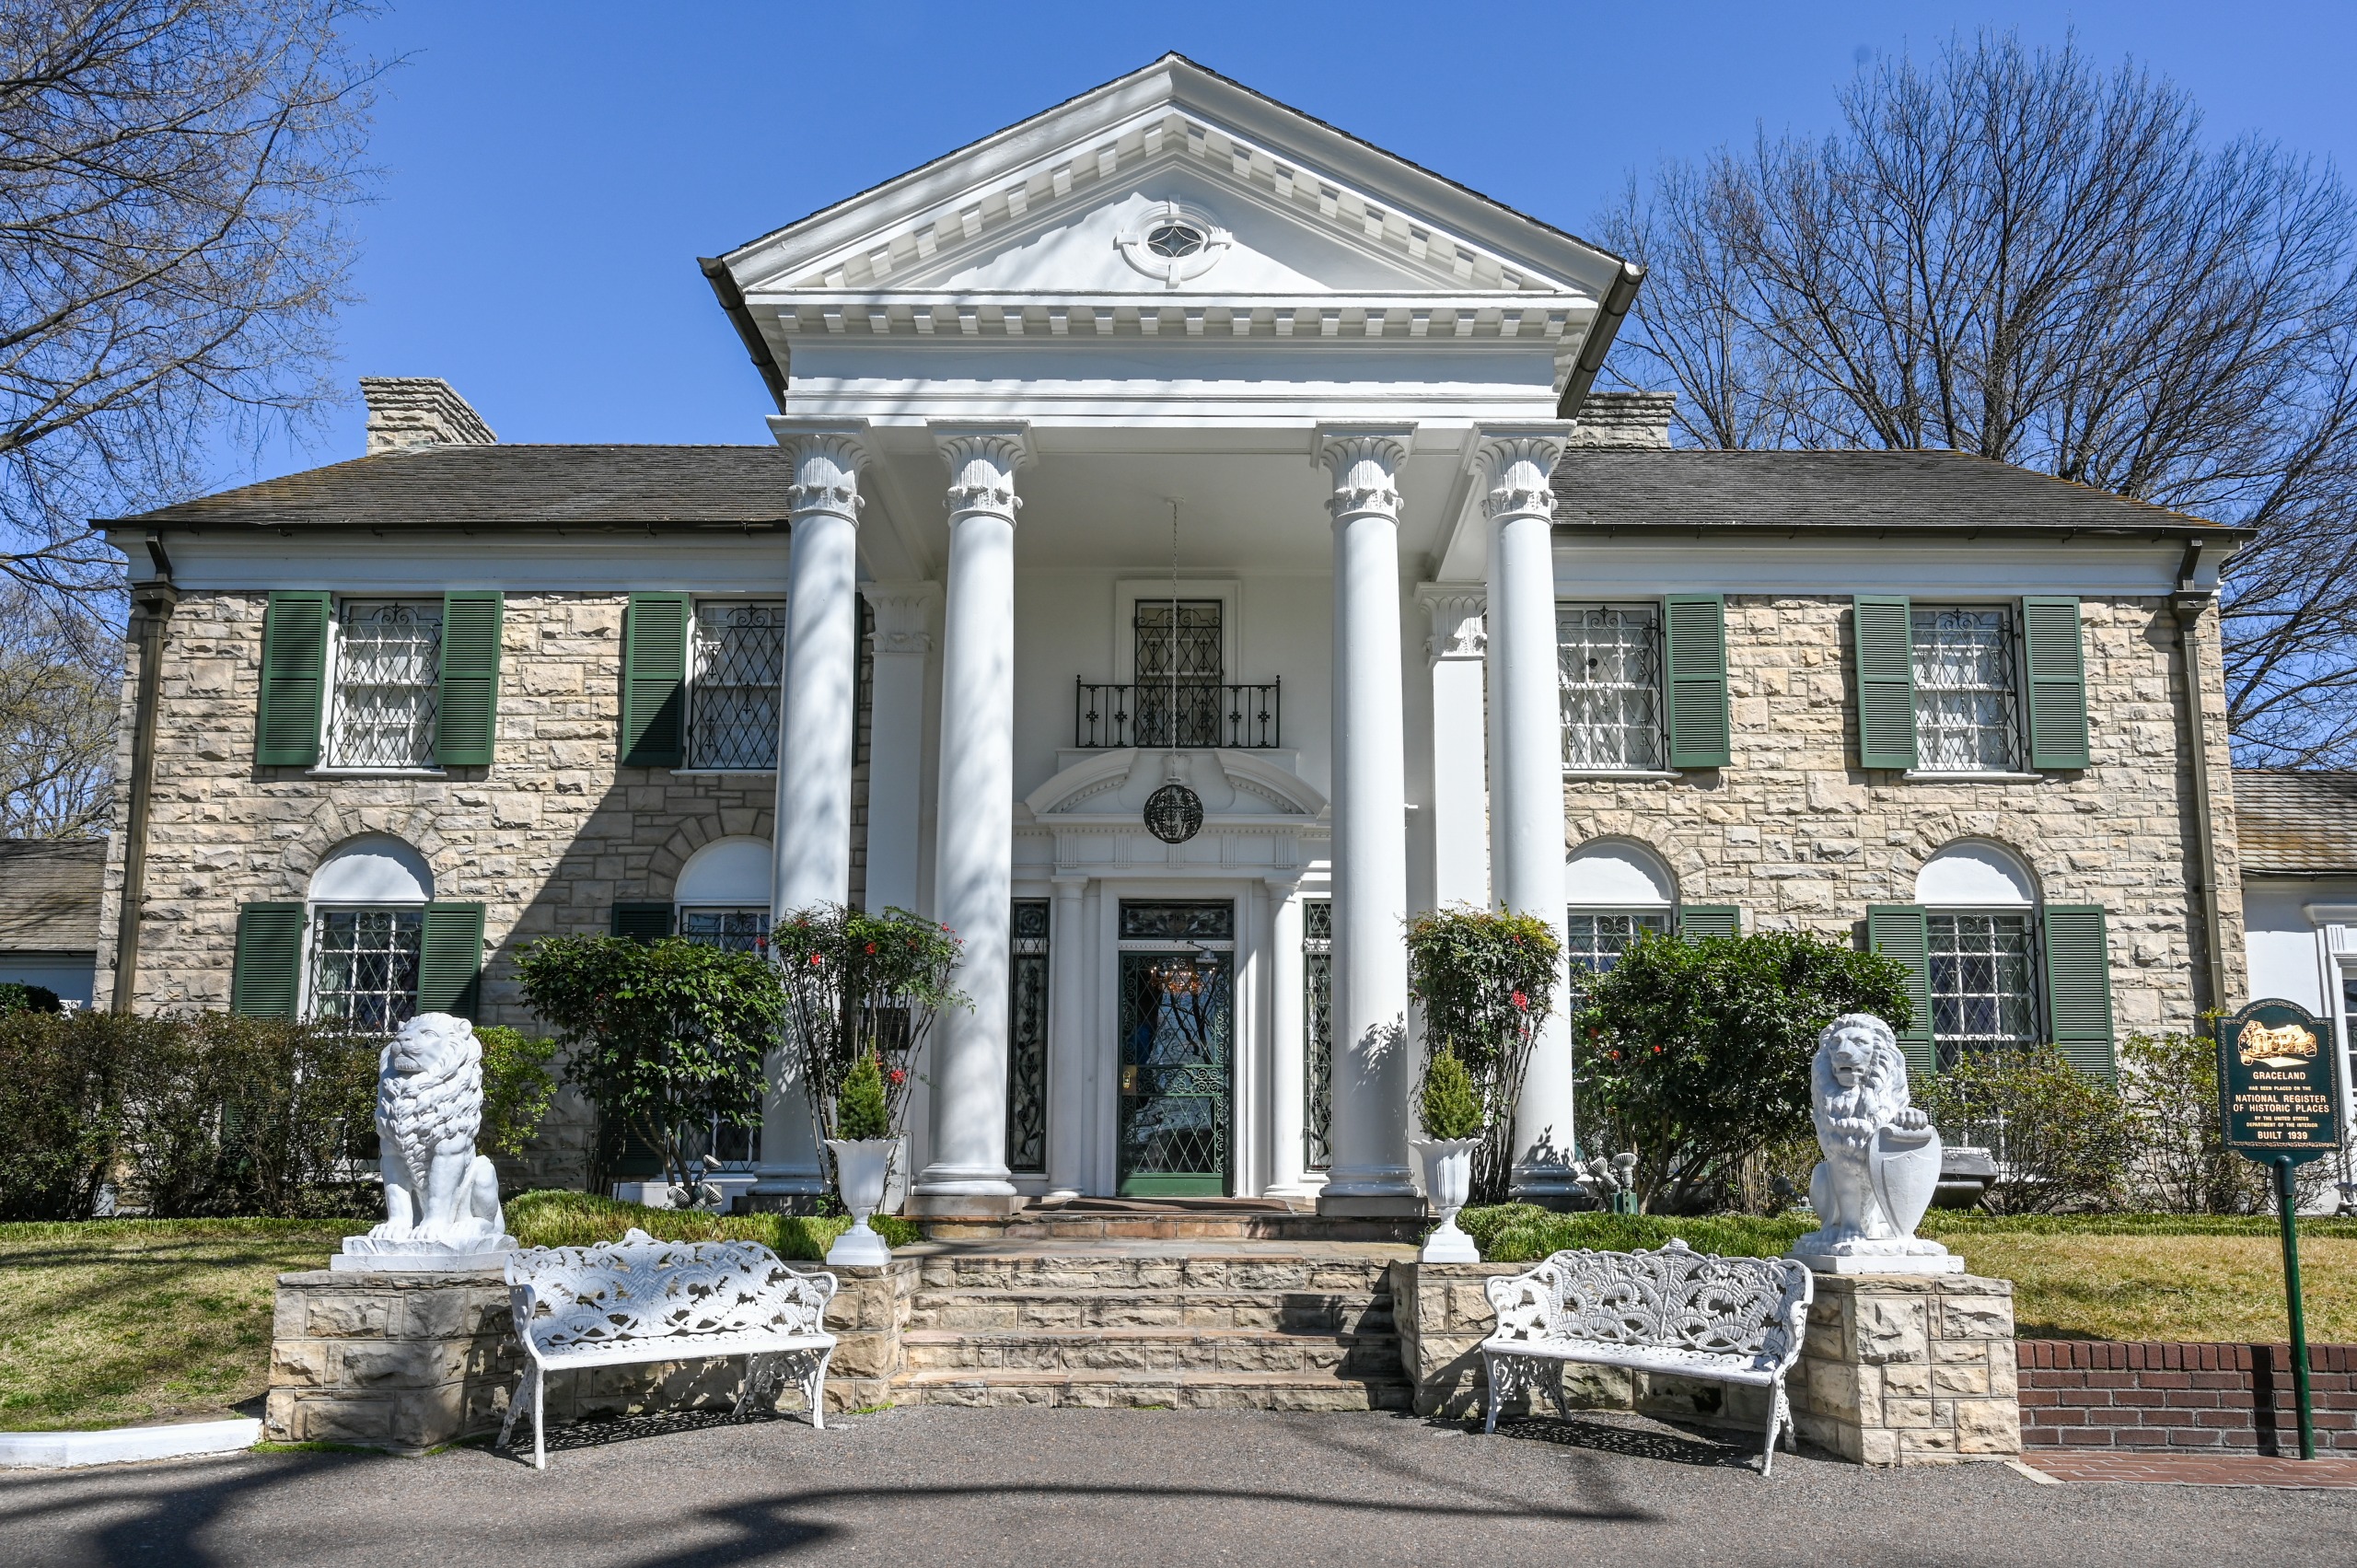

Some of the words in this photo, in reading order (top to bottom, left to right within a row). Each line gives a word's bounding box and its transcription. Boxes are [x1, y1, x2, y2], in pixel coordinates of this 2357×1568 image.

[2253, 1072, 2305, 1080] GRACELAND
[2283, 1095, 2326, 1103] REGISTER
[2234, 1104, 2244, 1112] OF
[2249, 1104, 2290, 1112] HISTORIC
[2295, 1105, 2329, 1113] PLACES
[2288, 1132, 2308, 1140] 1939
